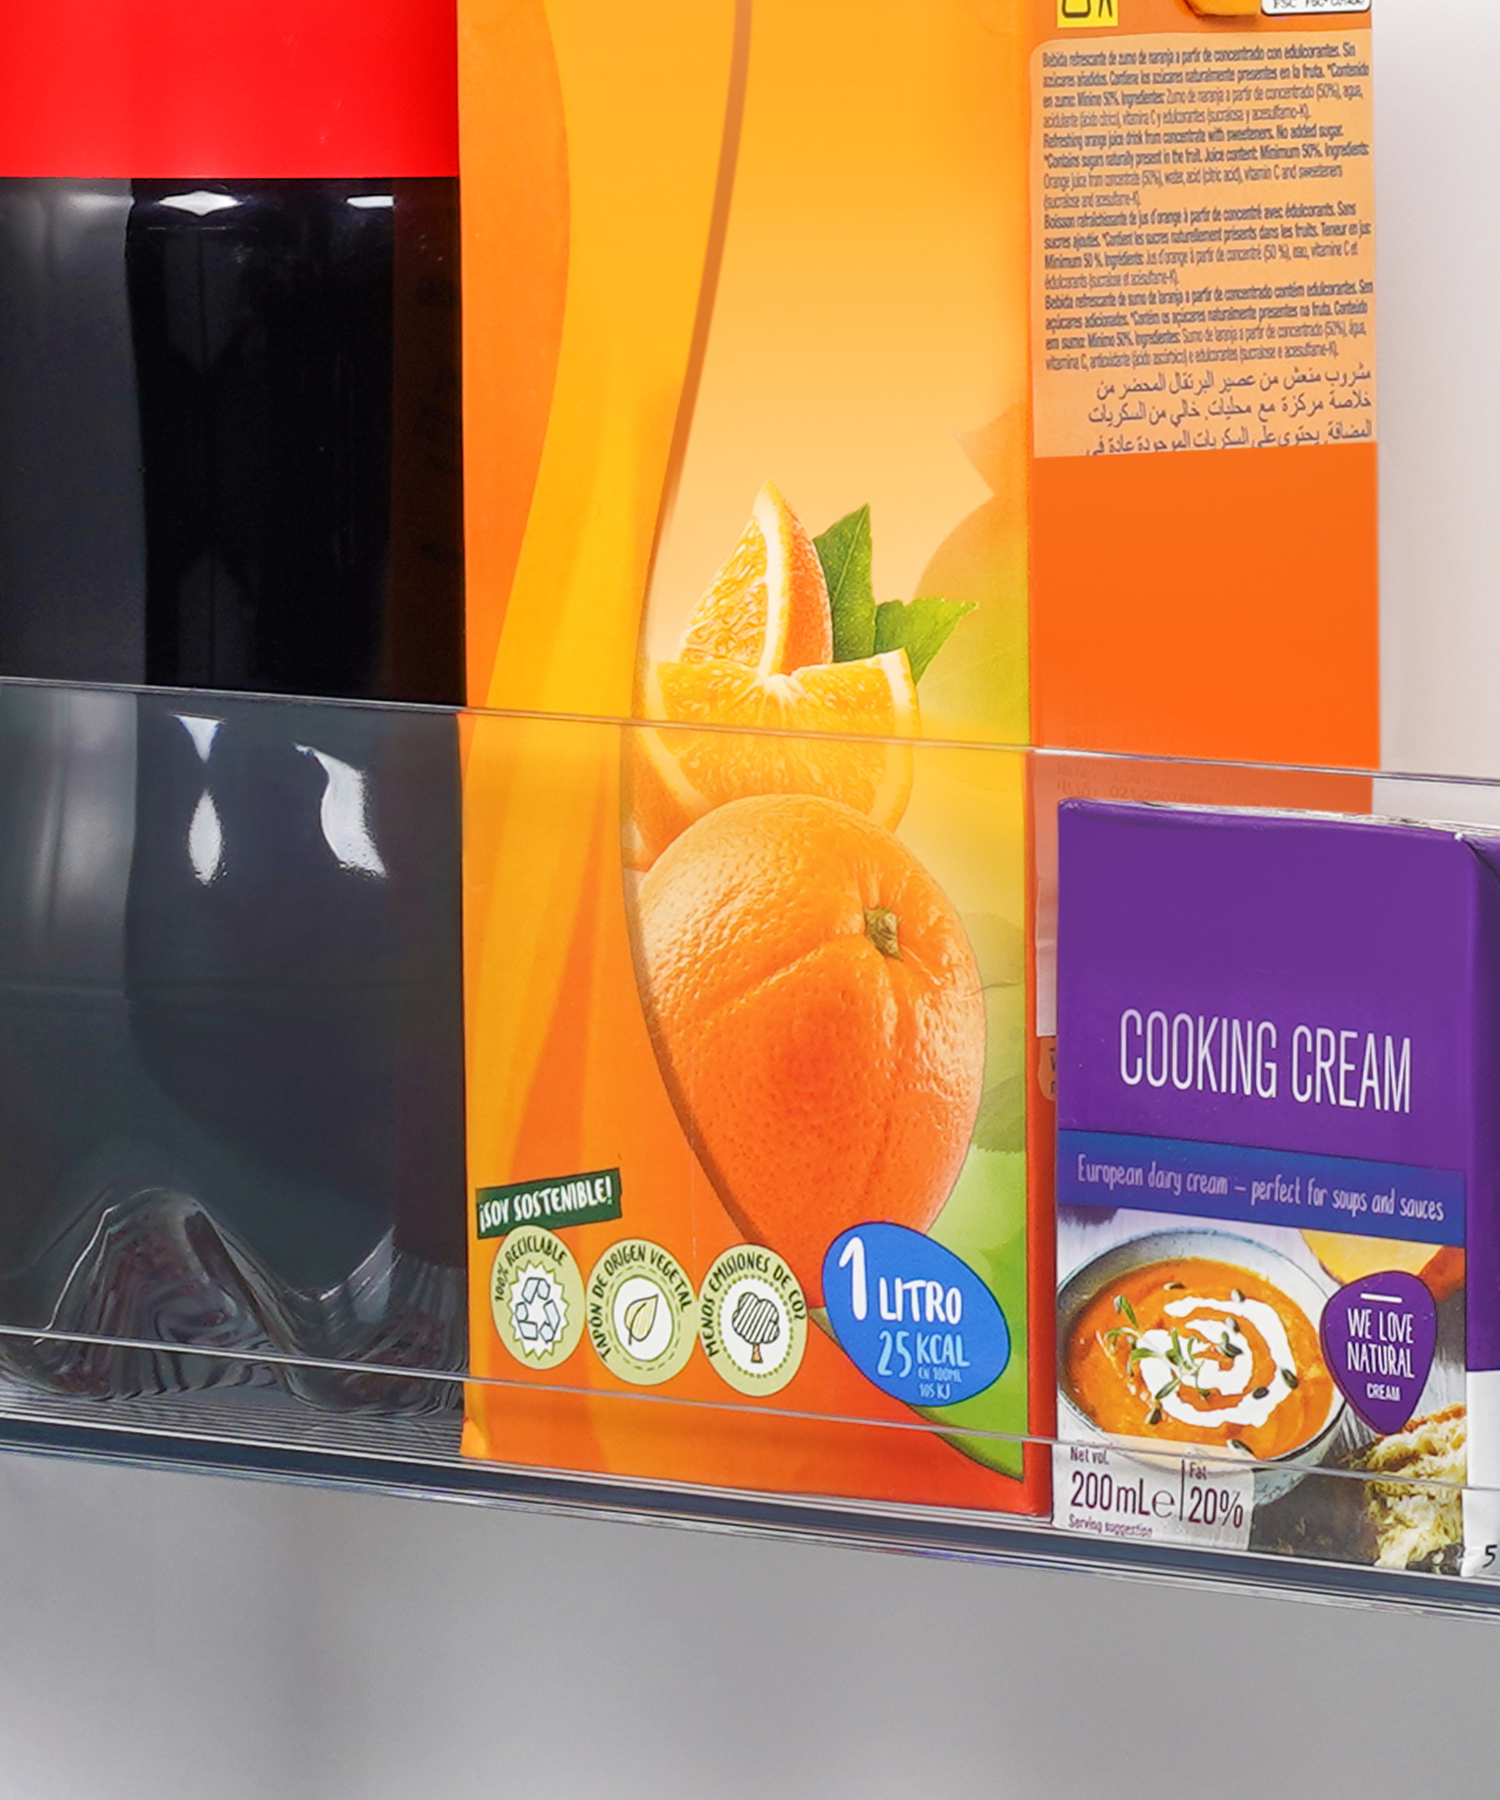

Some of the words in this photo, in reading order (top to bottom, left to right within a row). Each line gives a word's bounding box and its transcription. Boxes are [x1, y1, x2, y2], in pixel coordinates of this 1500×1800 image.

[1267, 48, 1282, 60] con
[1343, 41, 1356, 57] Sin
[1237, 67, 1278, 83] presentes
[1280, 67, 1290, 79] en
[1292, 64, 1301, 79] la
[1276, 125, 1289, 140] No
[1290, 123, 1317, 139] added
[1260, 143, 1300, 160] Minimum
[1264, 207, 1283, 220] avec
[1337, 200, 1356, 216] Sans
[1119, 372, 1166, 399] المحضر
[1219, 375, 1256, 394] عصير
[1260, 372, 1279, 391] من
[1283, 367, 1321, 390] منعش
[1325, 362, 1371, 387] مشروب
[1097, 381, 1115, 401] من
[1329, 389, 1372, 409] خلاصة
[1088, 400, 1146, 428] السكريات
[1149, 406, 1166, 425] من
[1258, 400, 1276, 423] مع
[1282, 392, 1324, 417] مركزة
[1119, 1008, 1277, 1099] COOKING
[1291, 1024, 1411, 1113] CREAM
[1077, 1154, 1143, 1191] European
[1148, 1160, 1182, 1197] dairy
[1186, 1172, 1228, 1196] cream
[1251, 1172, 1301, 1207] perfect
[1306, 1178, 1328, 1207] for
[1332, 1191, 1367, 1218] soups
[1371, 1189, 1396, 1214] and
[1399, 1193, 1445, 1222] sauces
[479, 1198, 510, 1233] ¡SOY
[513, 1175, 613, 1222] SOSTENIBLE!
[494, 1262, 509, 1302] 100%
[504, 1234, 568, 1267] RECICLABLE
[603, 1244, 647, 1277] ORIGEN
[708, 1251, 771, 1294] EMISIONES
[591, 1273, 609, 1299] DE
[649, 1248, 693, 1312] VEGETAL
[773, 1263, 792, 1290] DE
[838, 1236, 867, 1321] 1
[878, 1277, 962, 1325] LITRO
[588, 1302, 611, 1363] TAPÓN
[700, 1292, 720, 1358] MENOS
[1347, 1308, 1372, 1339] WE
[1379, 1310, 1414, 1344] LOVE
[878, 1330, 912, 1378] 25
[916, 1331, 971, 1367] KCAL
[1347, 1341, 1415, 1378] NATURAL
[1366, 1383, 1400, 1401] CREAM
[1070, 1446, 1090, 1464] Net
[1189, 1461, 1207, 1481] Fat
[1188, 1486, 1244, 1529] 20%
[1068, 1513, 1103, 1534] Serving
[1482, 1544, 1498, 1569] 5
